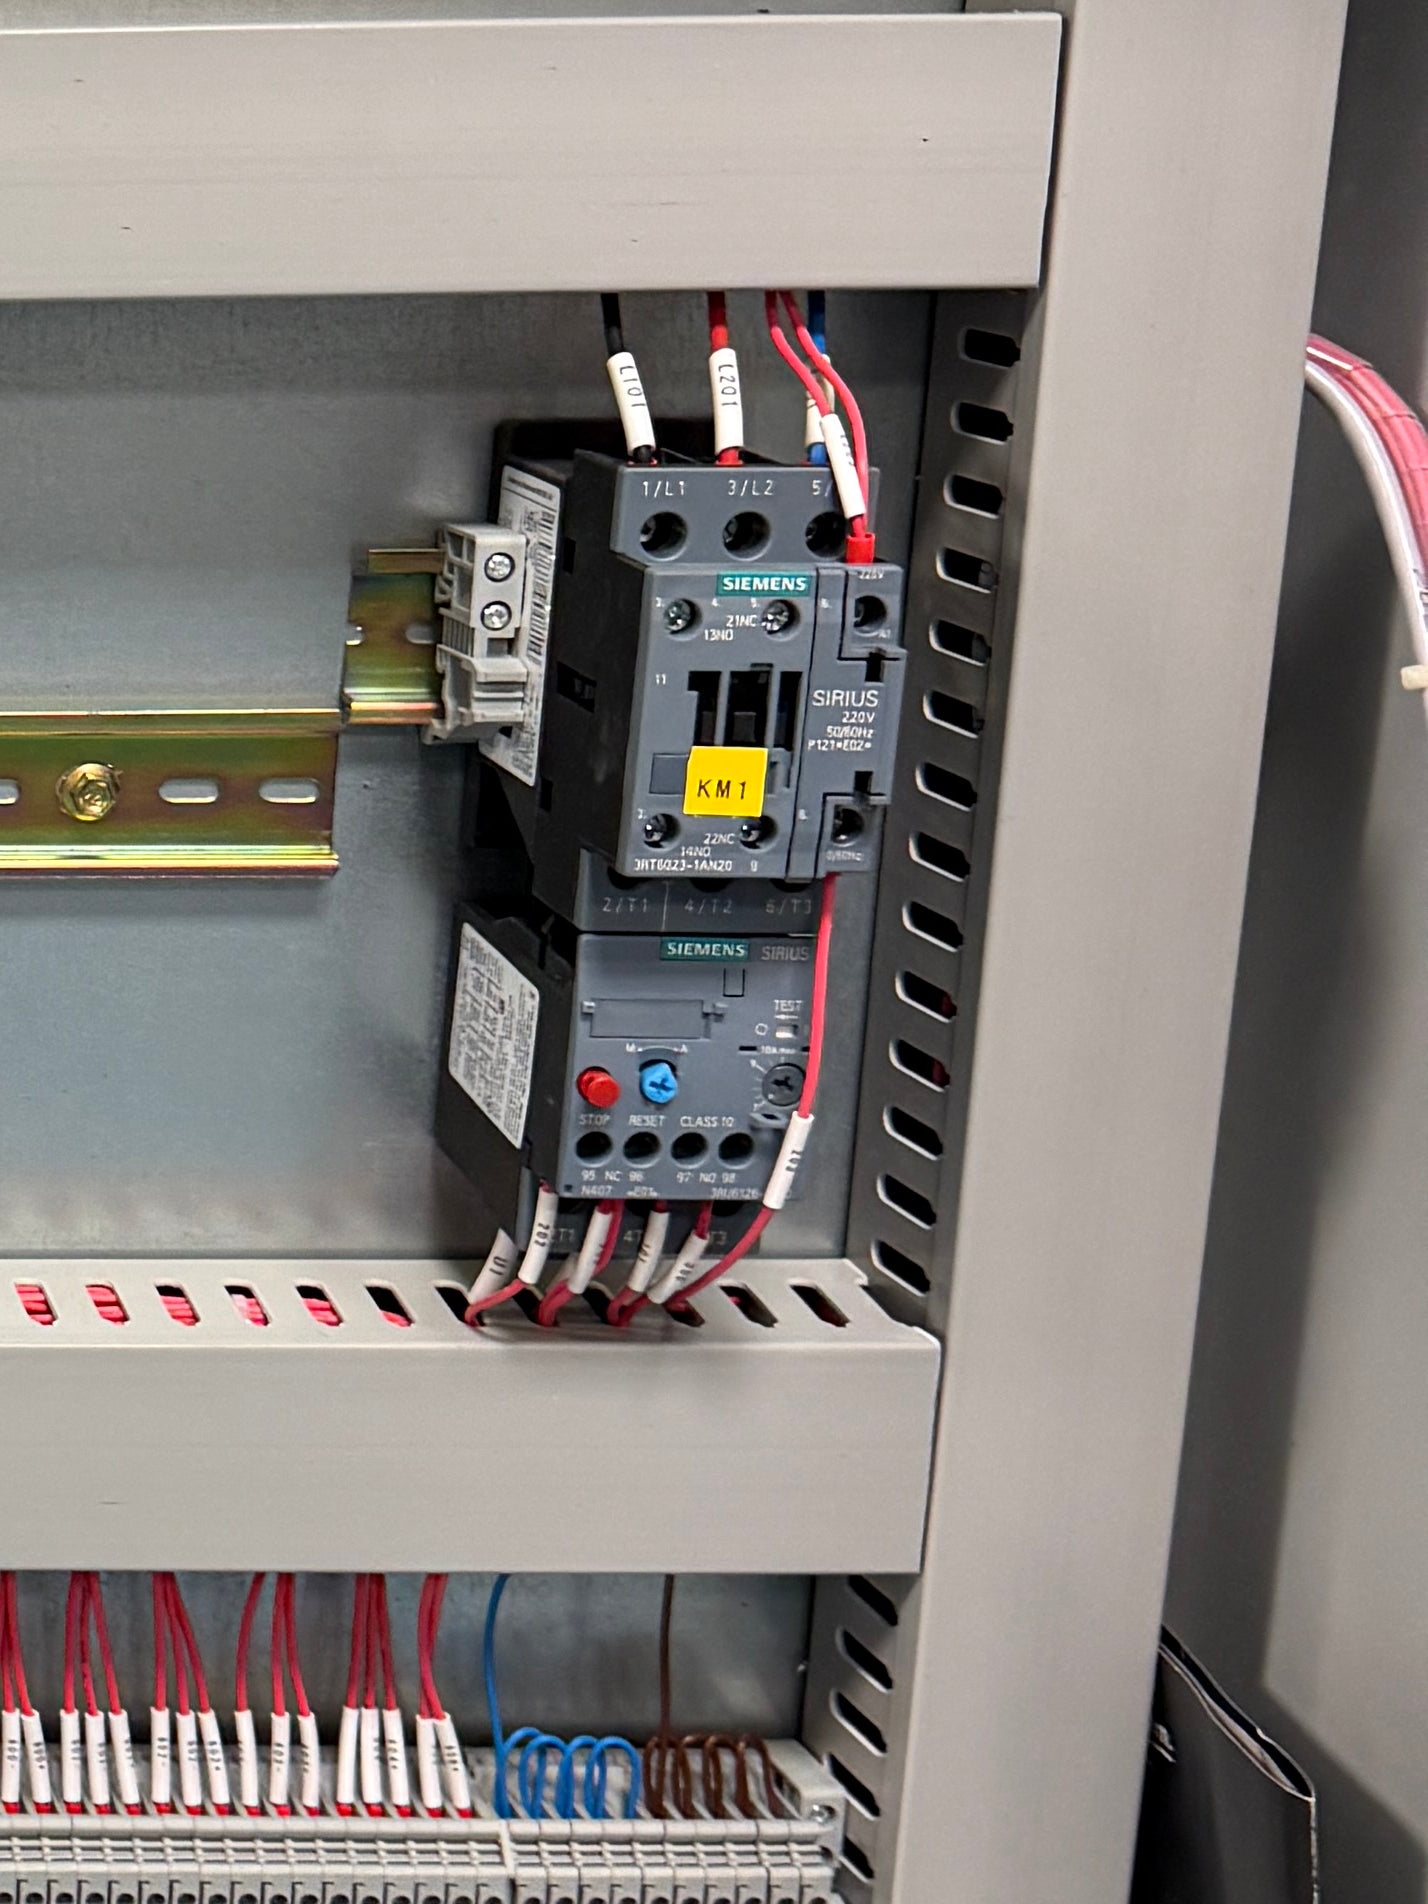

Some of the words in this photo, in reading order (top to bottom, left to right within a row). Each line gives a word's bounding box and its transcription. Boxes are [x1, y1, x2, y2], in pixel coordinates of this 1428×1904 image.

[619, 364, 646, 408] L101
[718, 363, 740, 408] L201
[642, 480, 686, 498] 1/L1
[727, 479, 774, 497] 3/L2
[722, 576, 808, 593] SIEMENS
[725, 615, 758, 628] 21NC
[703, 629, 735, 642] 13NO
[812, 688, 880, 707] SIRIUS
[841, 710, 876, 724] 220V
[826, 724, 875, 739] 50/60Hz
[695, 777, 748, 801] KM1
[703, 832, 735, 845] 22NC
[680, 845, 711, 858] 14NO
[601, 897, 650, 914] 2/T1
[684, 897, 734, 915] 4/T2
[666, 941, 746, 957] SIEMENS
[760, 945, 810, 962] SIRIUS
[773, 999, 804, 1012] TEST
[578, 1113, 612, 1127] STOP
[628, 1113, 667, 1128] RESET
[679, 1114, 717, 1128] CLASS
